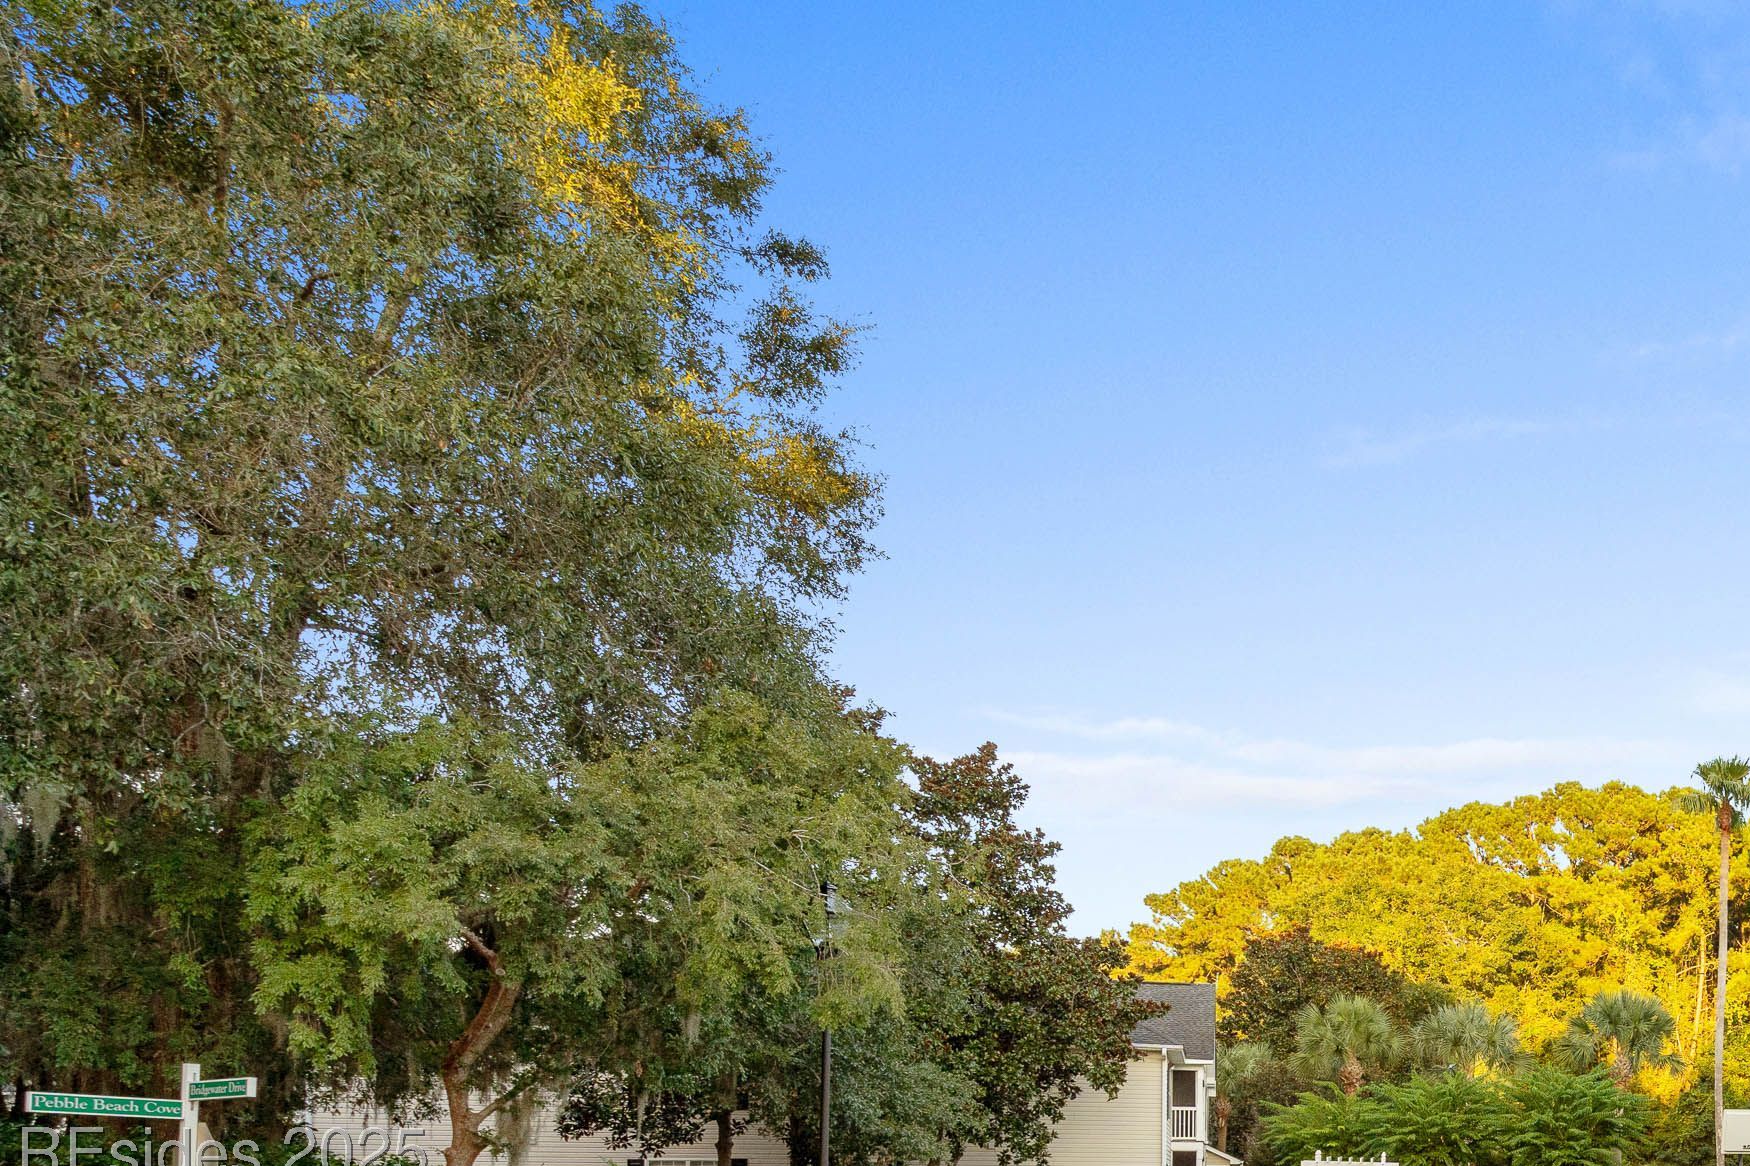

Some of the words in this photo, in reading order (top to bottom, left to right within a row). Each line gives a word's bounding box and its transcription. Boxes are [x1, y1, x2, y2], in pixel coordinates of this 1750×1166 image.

[190, 1084, 227, 1097] Bridgewater
[228, 1081, 246, 1093] Drive
[34, 1096, 88, 1110] Pebble
[93, 1099, 139, 1112] Beach
[144, 1102, 181, 1114] Cove
